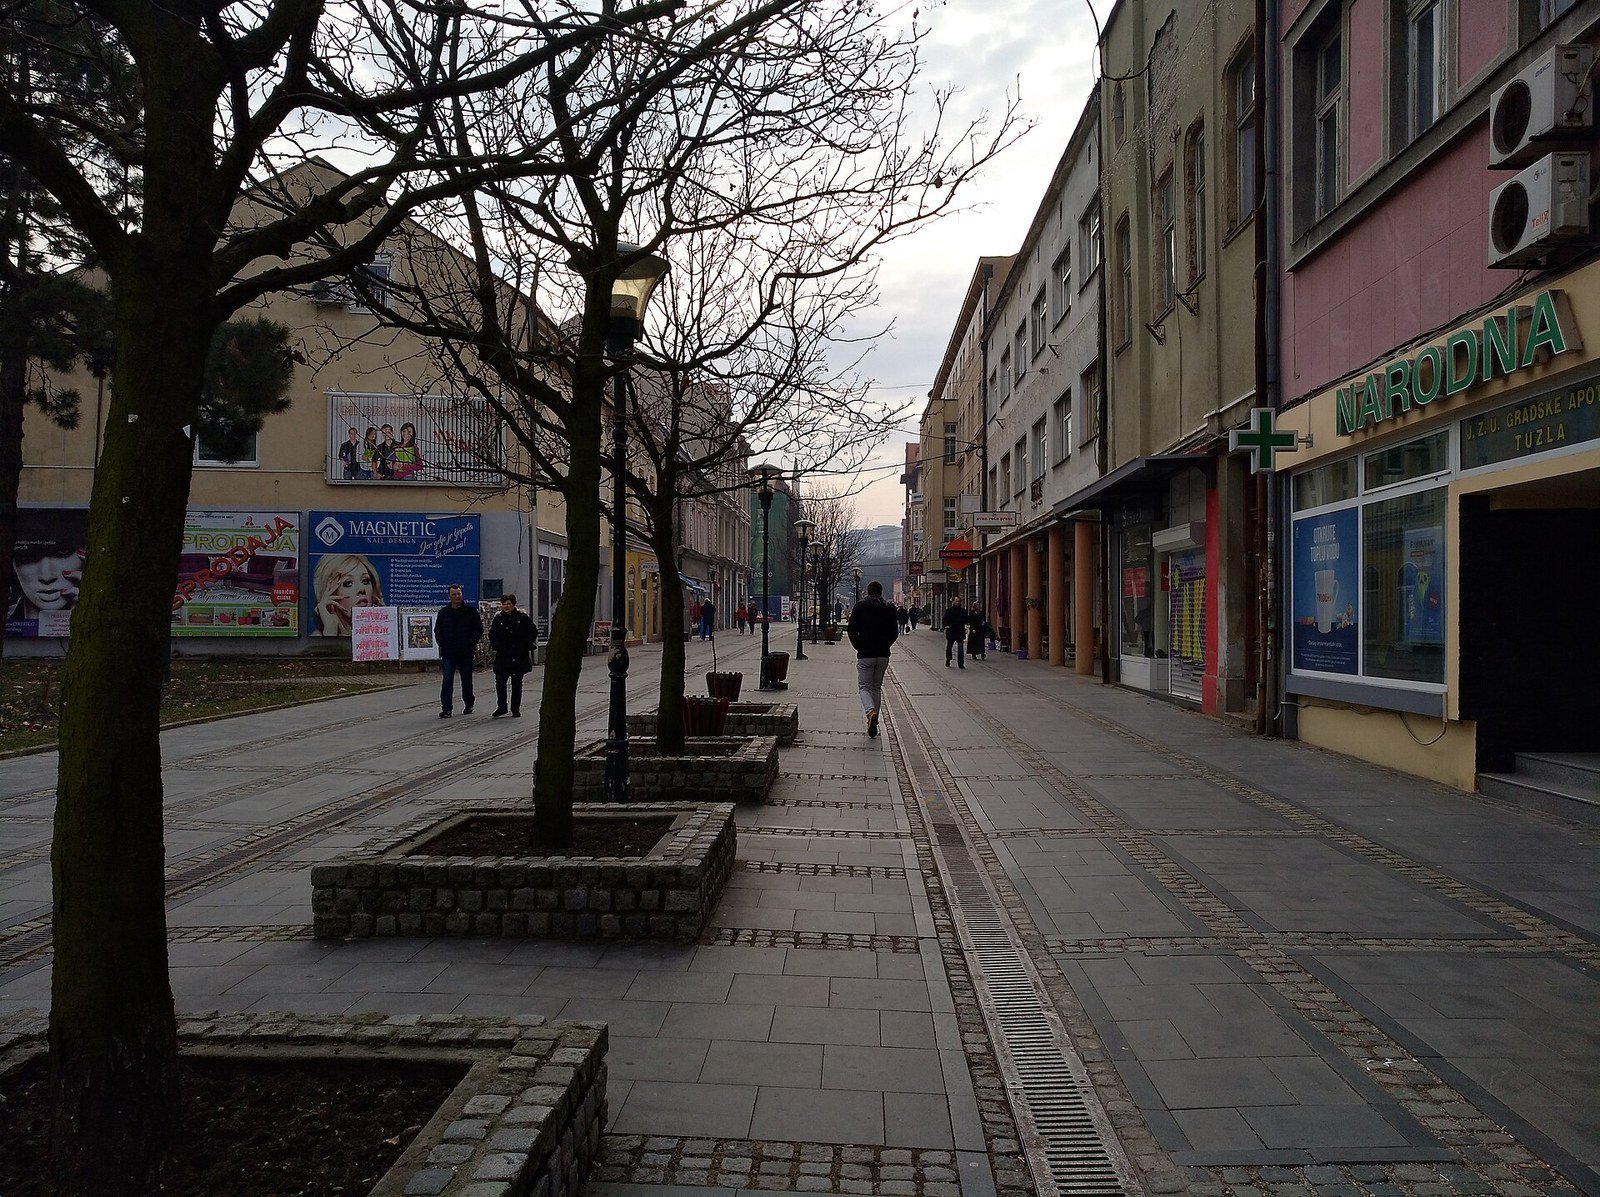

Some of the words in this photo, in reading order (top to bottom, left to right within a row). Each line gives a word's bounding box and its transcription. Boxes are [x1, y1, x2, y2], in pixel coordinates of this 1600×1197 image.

[1336, 290, 1567, 438] NARODNA
[1506, 397, 1562, 428] GRADSKE
[1514, 423, 1566, 451] TUZLA
[348, 520, 436, 537] MAGNETIC
